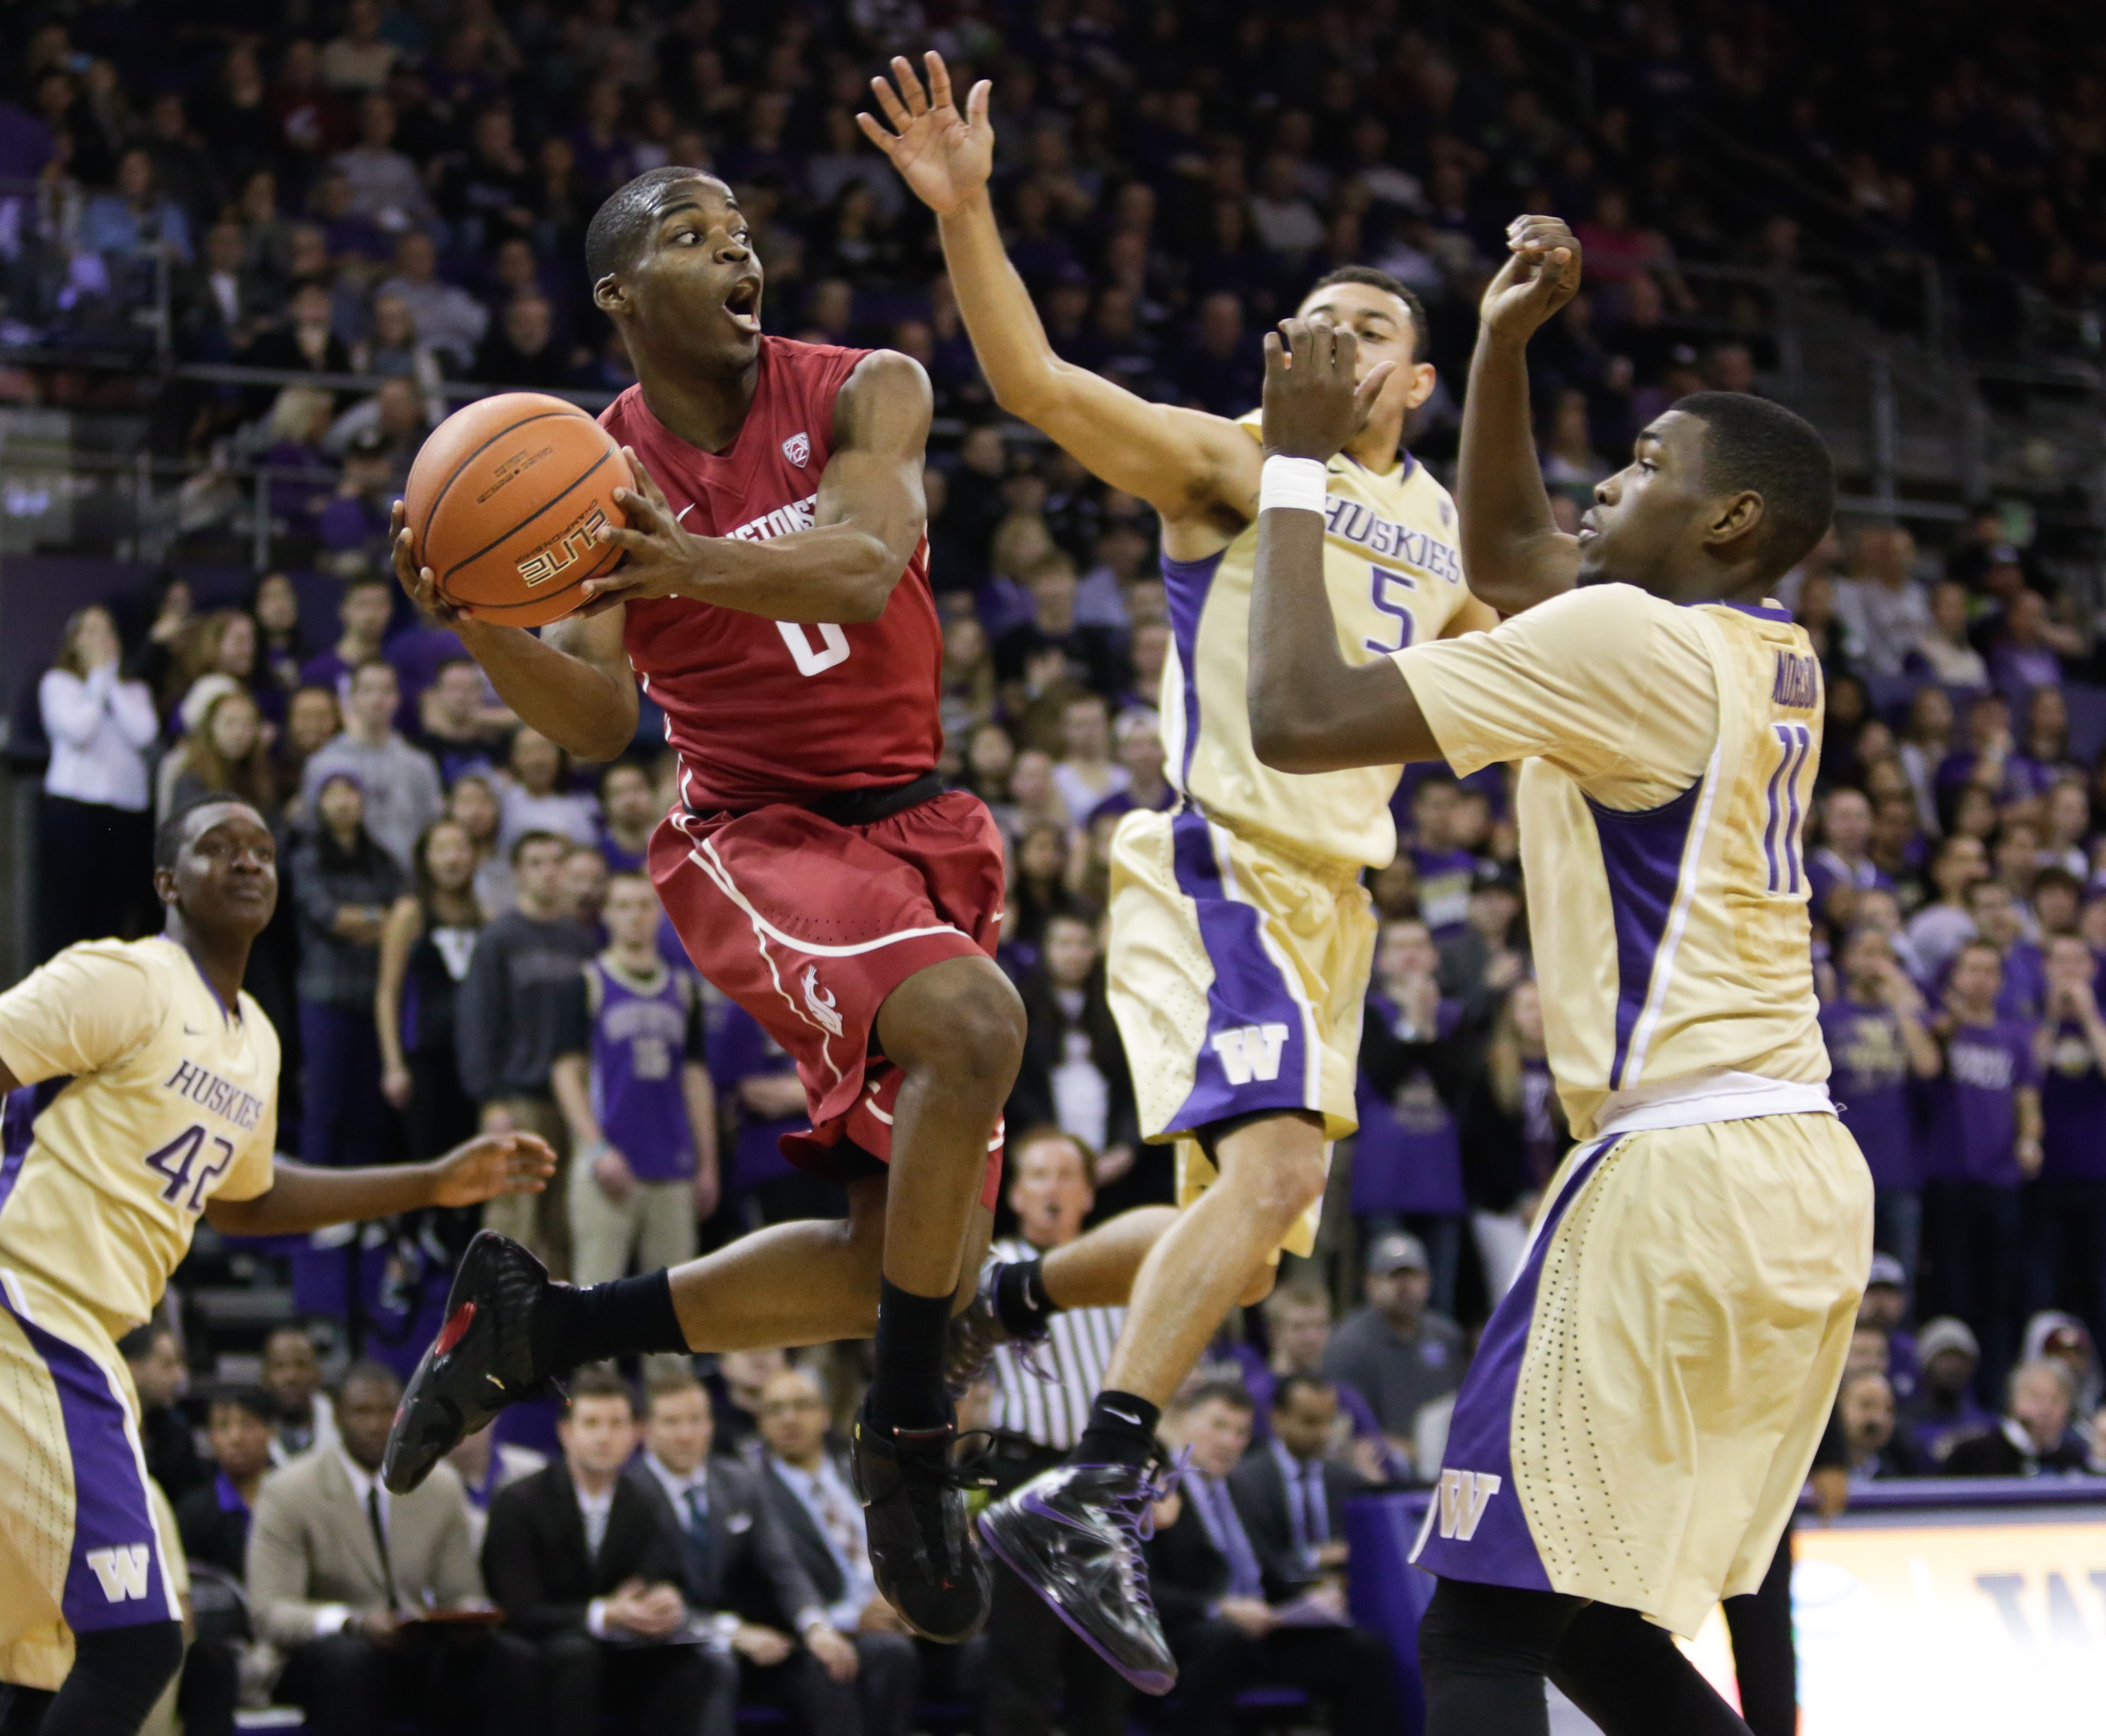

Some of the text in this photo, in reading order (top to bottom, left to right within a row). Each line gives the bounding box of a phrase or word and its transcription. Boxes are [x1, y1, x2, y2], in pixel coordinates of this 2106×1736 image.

[517, 505, 613, 588] ELITE
[1325, 493, 1461, 586] HUSKIES
[1362, 561, 1418, 656] 5
[1763, 723, 1812, 897] 11
[1211, 1022, 1290, 1085] W
[163, 1058, 264, 1133] HUSKIES
[144, 1123, 236, 1215] 42
[1438, 1467, 1502, 1542] W
[85, 1542, 150, 1604] W
